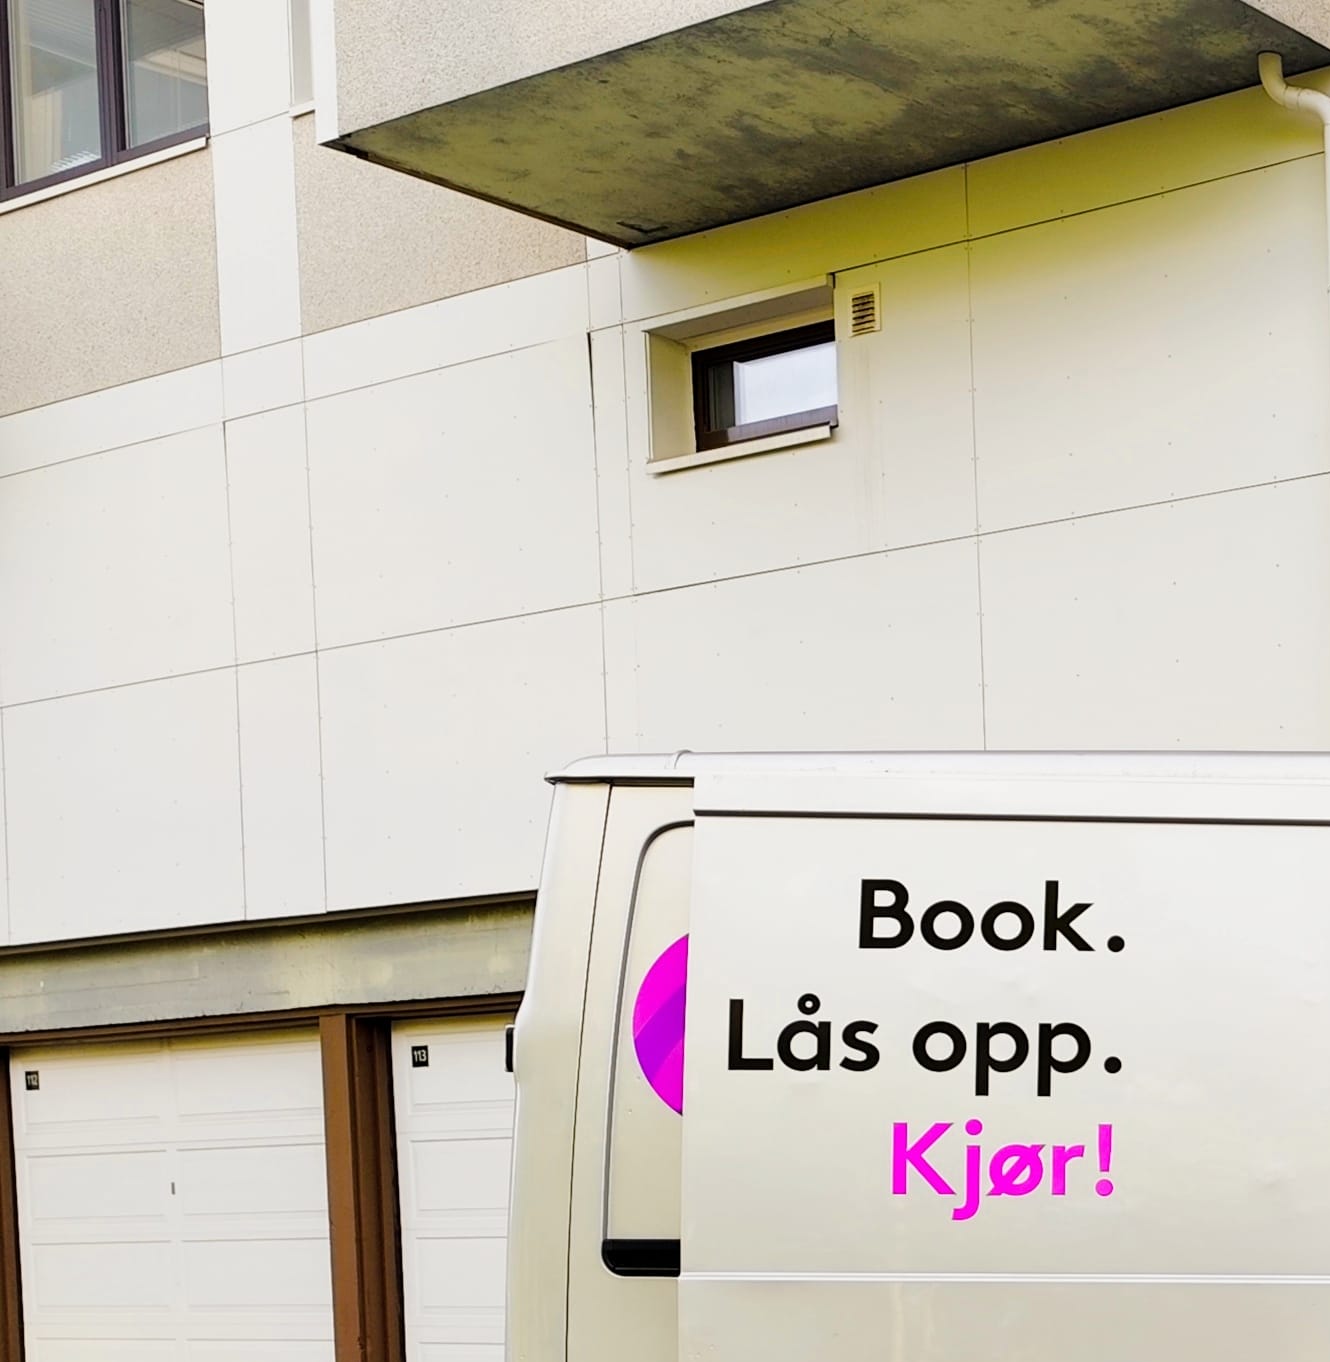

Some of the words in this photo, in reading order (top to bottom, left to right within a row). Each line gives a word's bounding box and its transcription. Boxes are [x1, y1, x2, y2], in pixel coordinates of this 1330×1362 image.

[858, 878, 1125, 953] Book.
[727, 993, 880, 1072] Lås
[912, 1020, 1122, 1097] opp.
[889, 1118, 1115, 1221] Kjør!
